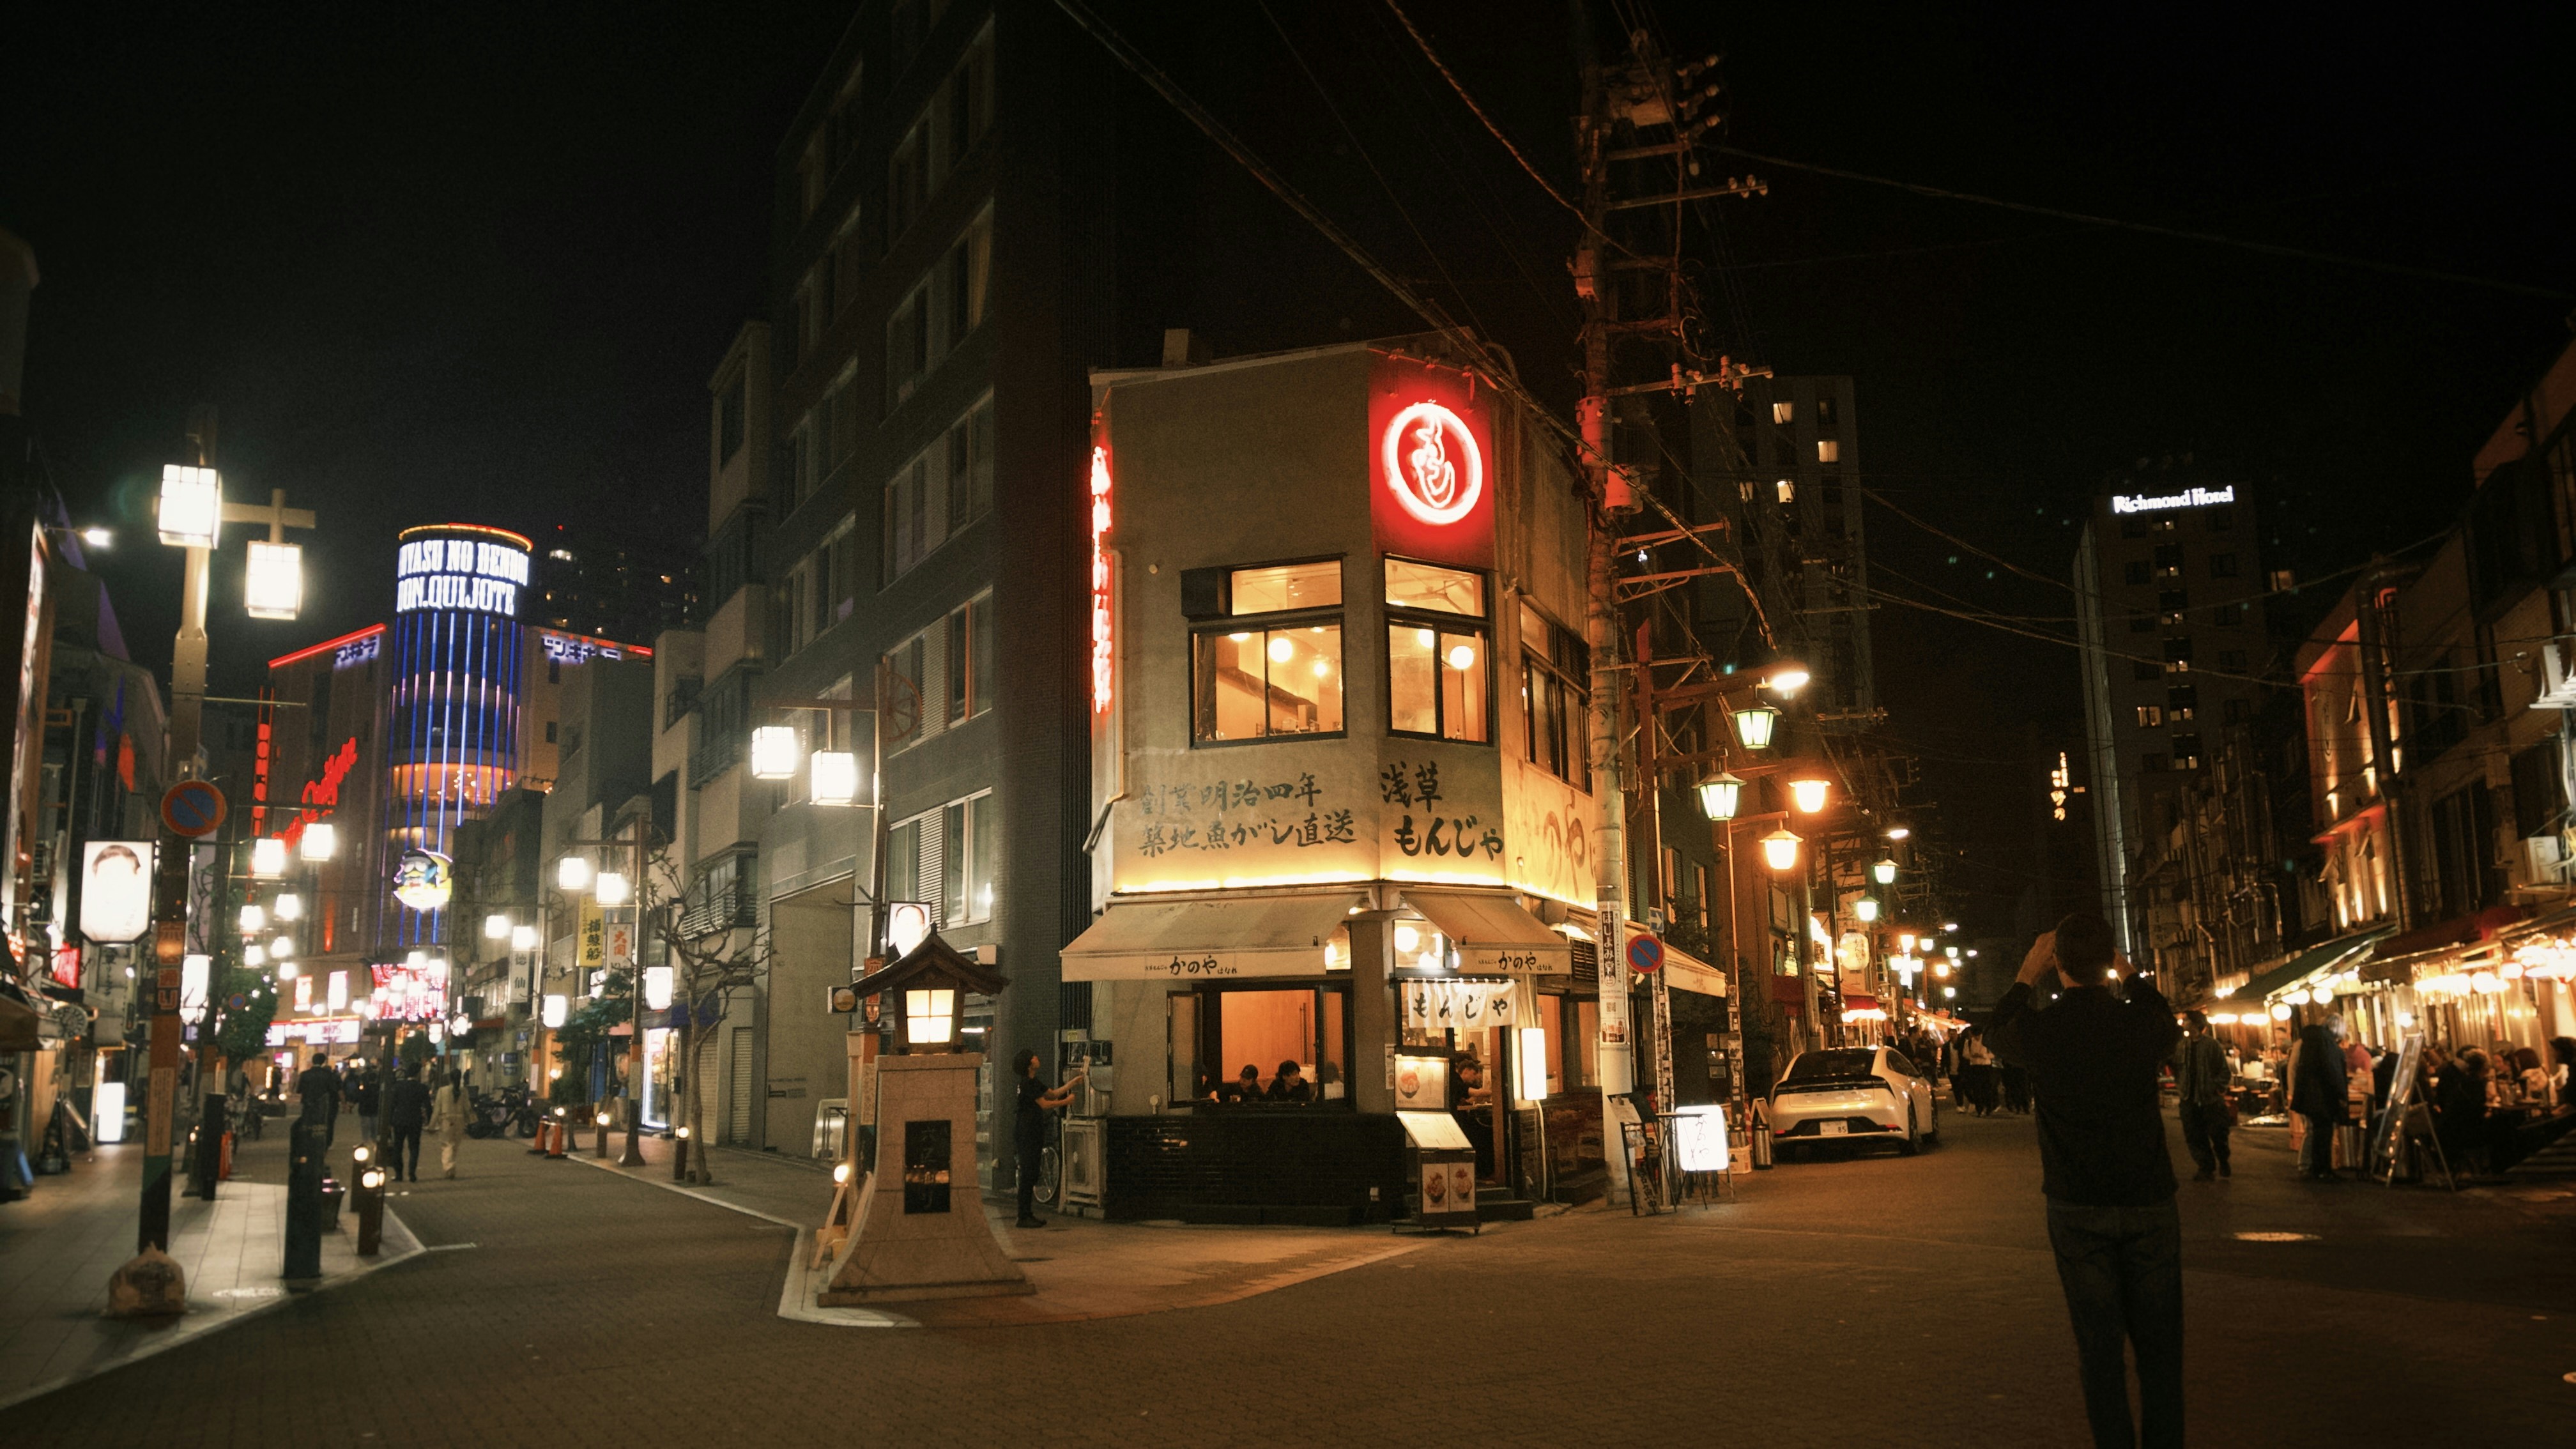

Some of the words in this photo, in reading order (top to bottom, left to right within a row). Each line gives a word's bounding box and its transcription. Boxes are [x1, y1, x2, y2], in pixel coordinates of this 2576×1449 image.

[2113, 494, 2191, 514] Richmond
[2191, 485, 2234, 506] Hotel
[447, 540, 473, 572] NO
[1140, 772, 1322, 816] 創業明治四年
[1381, 760, 1443, 813] 浅草
[1138, 809, 1357, 857] 築地魚がし直送
[1393, 815, 1504, 861] もんじゃ
[1169, 954, 1218, 976] かのや
[1217, 967, 1238, 975] はなれ
[1498, 951, 1537, 970] かのや
[1413, 992, 1508, 1020] もんじゃ
